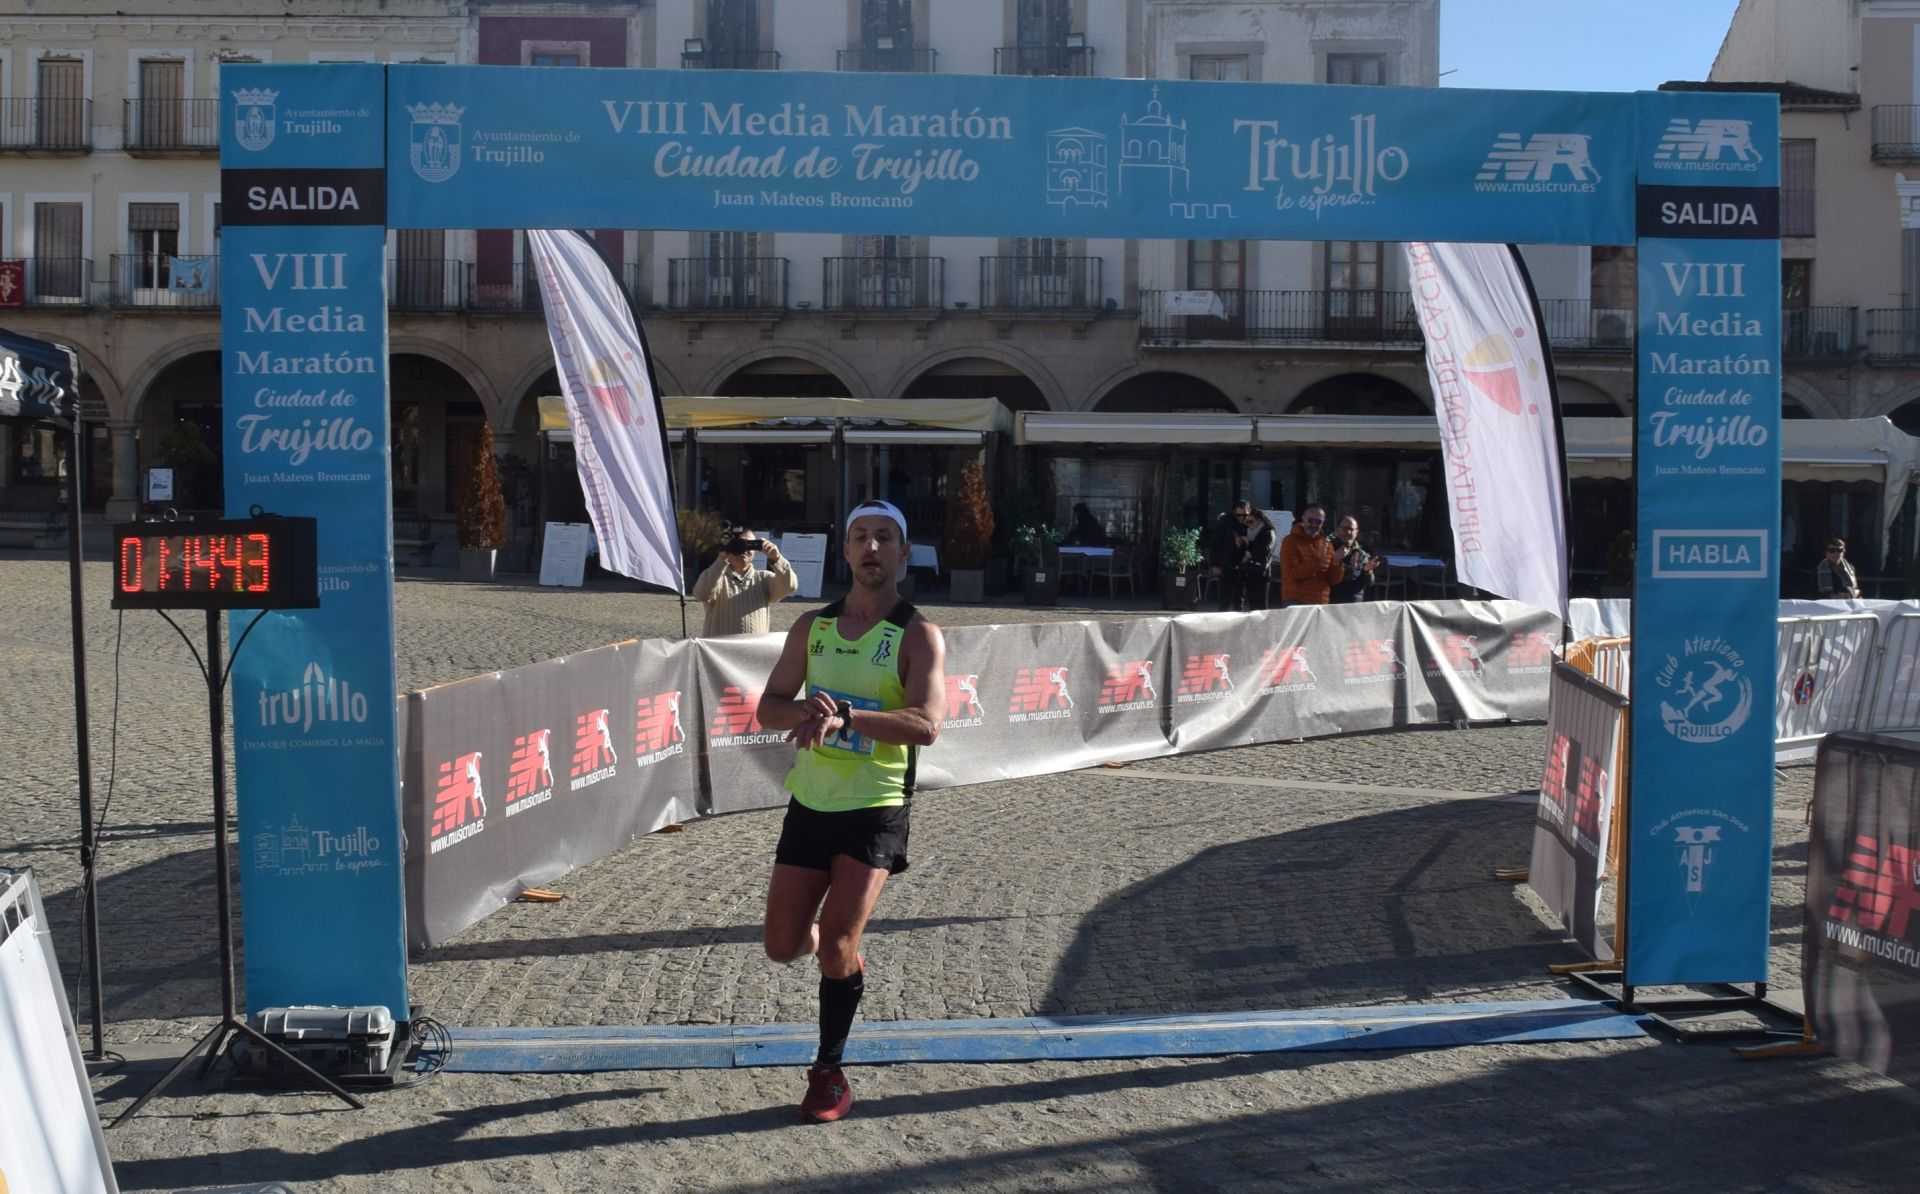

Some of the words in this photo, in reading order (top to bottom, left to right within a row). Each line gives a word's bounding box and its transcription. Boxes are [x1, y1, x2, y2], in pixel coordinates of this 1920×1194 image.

[284, 108, 355, 119] Ayuntamiento
[358, 108, 370, 119] de
[602, 100, 687, 134] VIII
[701, 102, 830, 137] Media
[844, 105, 1013, 140] Maratón
[284, 120, 341, 135] Trujillo
[472, 129, 561, 145] Ayuntamiento
[564, 130, 580, 143] de
[472, 145, 544, 166] Trujillo
[653, 140, 787, 179] Ciudad
[793, 145, 841, 180] de
[851, 143, 981, 195] Trujillo
[1233, 113, 1409, 197] Trujillo
[1653, 159, 1758, 173] www.musicrun.es
[247, 186, 360, 211] SALIDA
[712, 189, 755, 208] Juan
[760, 190, 824, 207] Mateos
[829, 191, 913, 208] Broncano
[1276, 186, 1297, 211] te
[1474, 180, 1596, 194] www.musicrun.es
[1660, 201, 1759, 226] SALIDA
[249, 253, 348, 291] VIII
[1661, 262, 1745, 297] VIII
[243, 305, 366, 333] Media
[1656, 311, 1763, 336] Media
[235, 350, 376, 375] Maratón
[1650, 351, 1771, 375] Maratón
[254, 387, 327, 408] Ciudad
[330, 388, 355, 407] de
[1664, 386, 1726, 406] Ciudad
[1729, 387, 1752, 405] de
[236, 414, 374, 466] Trujillo
[1650, 411, 1768, 460] Trujillo
[243, 472, 270, 485] Juan
[273, 472, 314, 483] Mateos
[317, 472, 371, 482] Broncano
[1655, 465, 1679, 477] Juan
[1681, 465, 1717, 475] Mateos
[1719, 465, 1766, 475] Broncano
[122, 533, 270, 592] 01:14:43
[1668, 544, 1751, 564] HABLA
[1655, 654, 1679, 688] Club
[1684, 635, 1745, 668] Atletismo
[1098, 700, 1154, 714] www.musicrun.es
[1177, 690, 1233, 703] www.musicrun.es
[1008, 709, 1071, 723] www.musicrun.es
[1667, 719, 1732, 738] TRUJILLO
[267, 740, 287, 750] QUE
[289, 739, 338, 748] COMIENCE
[355, 737, 385, 747] MAGIA
[636, 743, 683, 768] www.musicrun.es
[570, 766, 616, 792] www.musicrun.es
[505, 787, 552, 818] www.musicrun.es
[1649, 820, 1669, 836] Club
[1711, 809, 1729, 820] San
[312, 826, 380, 857] Trujillo
[430, 819, 485, 854] www.musicrun.es
[335, 858, 345, 871] te
